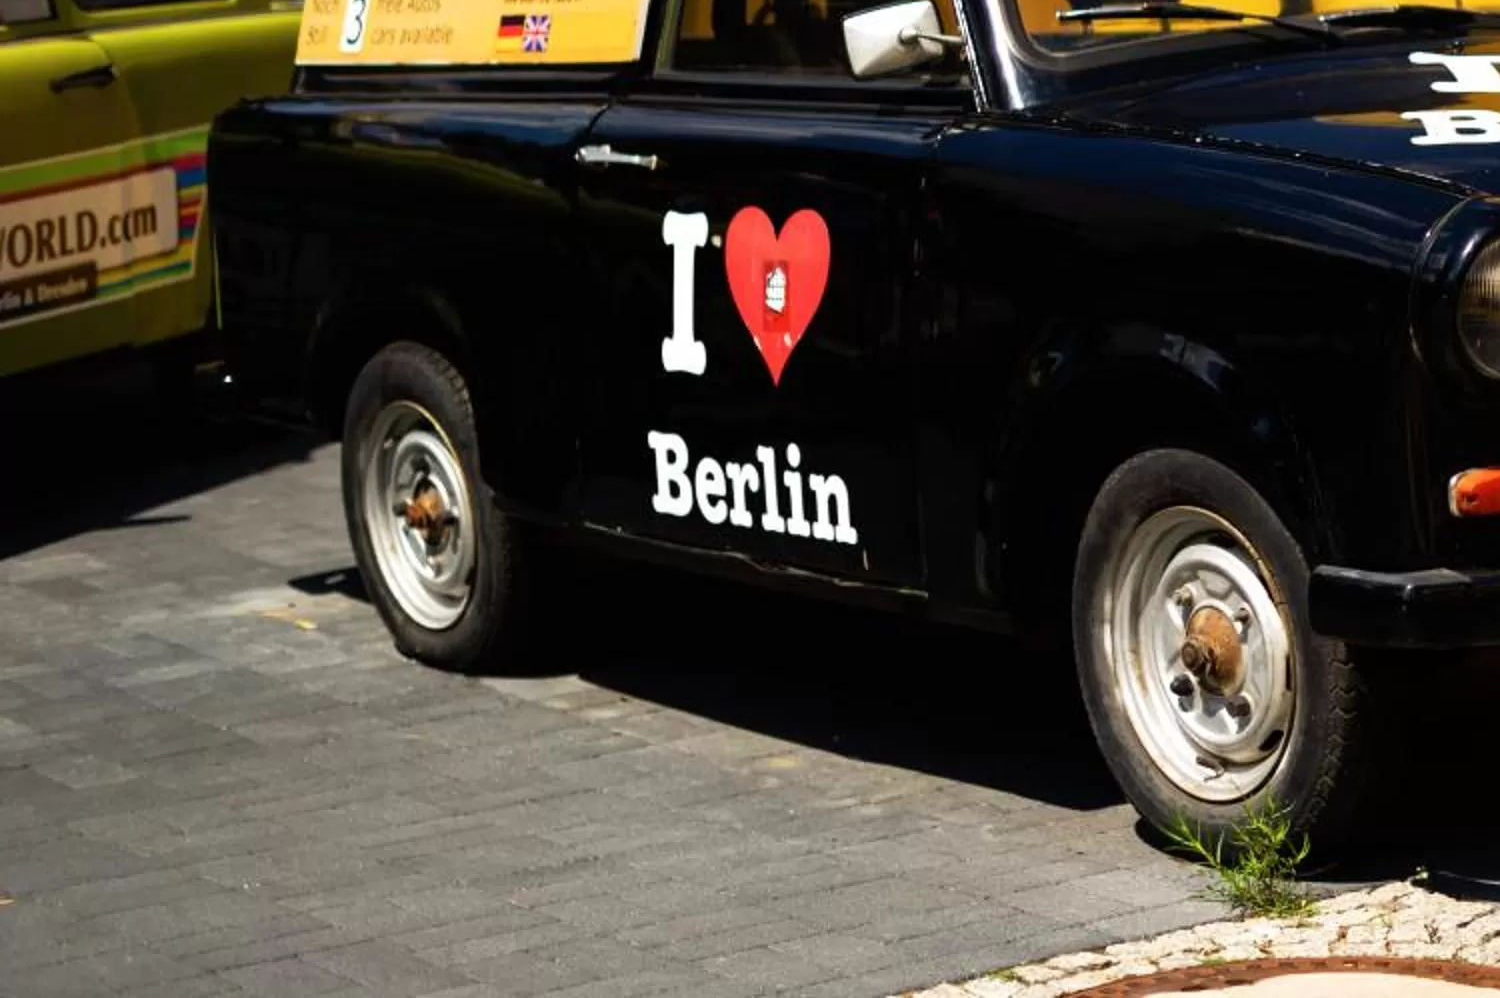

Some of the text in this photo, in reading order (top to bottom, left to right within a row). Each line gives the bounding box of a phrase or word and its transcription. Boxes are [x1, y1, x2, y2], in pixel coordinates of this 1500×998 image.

[0, 203, 157, 270] ORLD.com
[662, 209, 708, 376] I
[647, 430, 858, 545] Berlin
